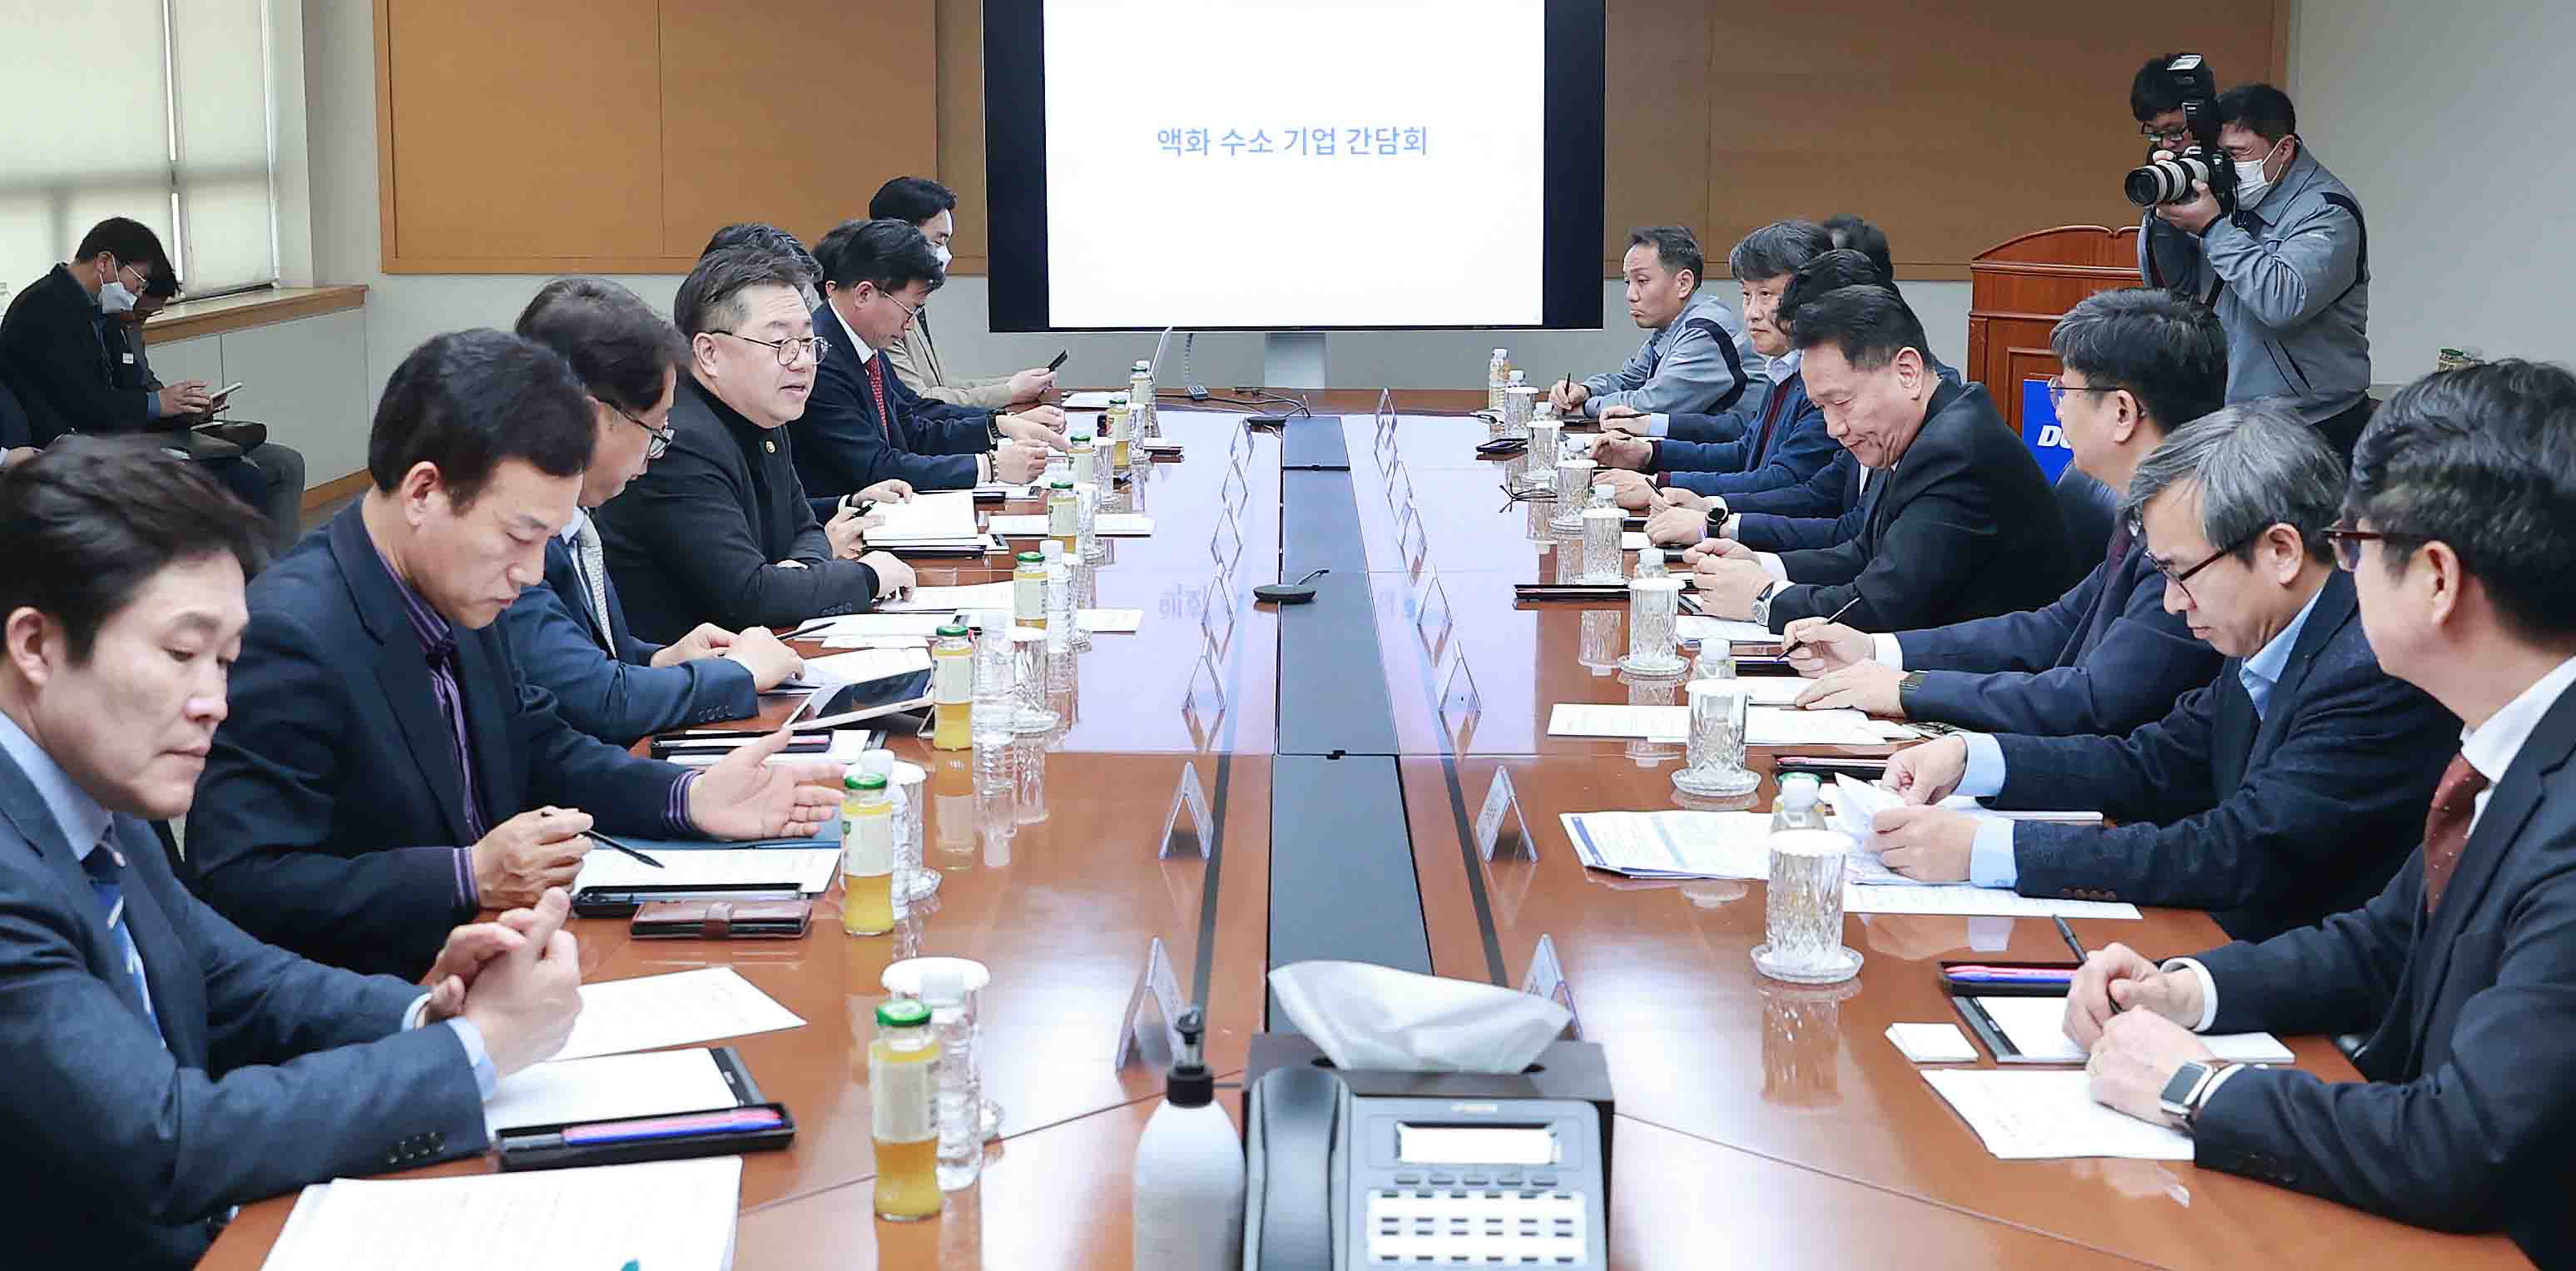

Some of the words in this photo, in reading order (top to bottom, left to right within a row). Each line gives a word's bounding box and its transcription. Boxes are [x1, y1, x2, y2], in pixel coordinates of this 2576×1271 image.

[1157, 127, 1211, 156] 액화
[1220, 128, 1274, 156] 수소
[1284, 127, 1335, 156] 기업
[1346, 126, 1427, 156] 간담회
